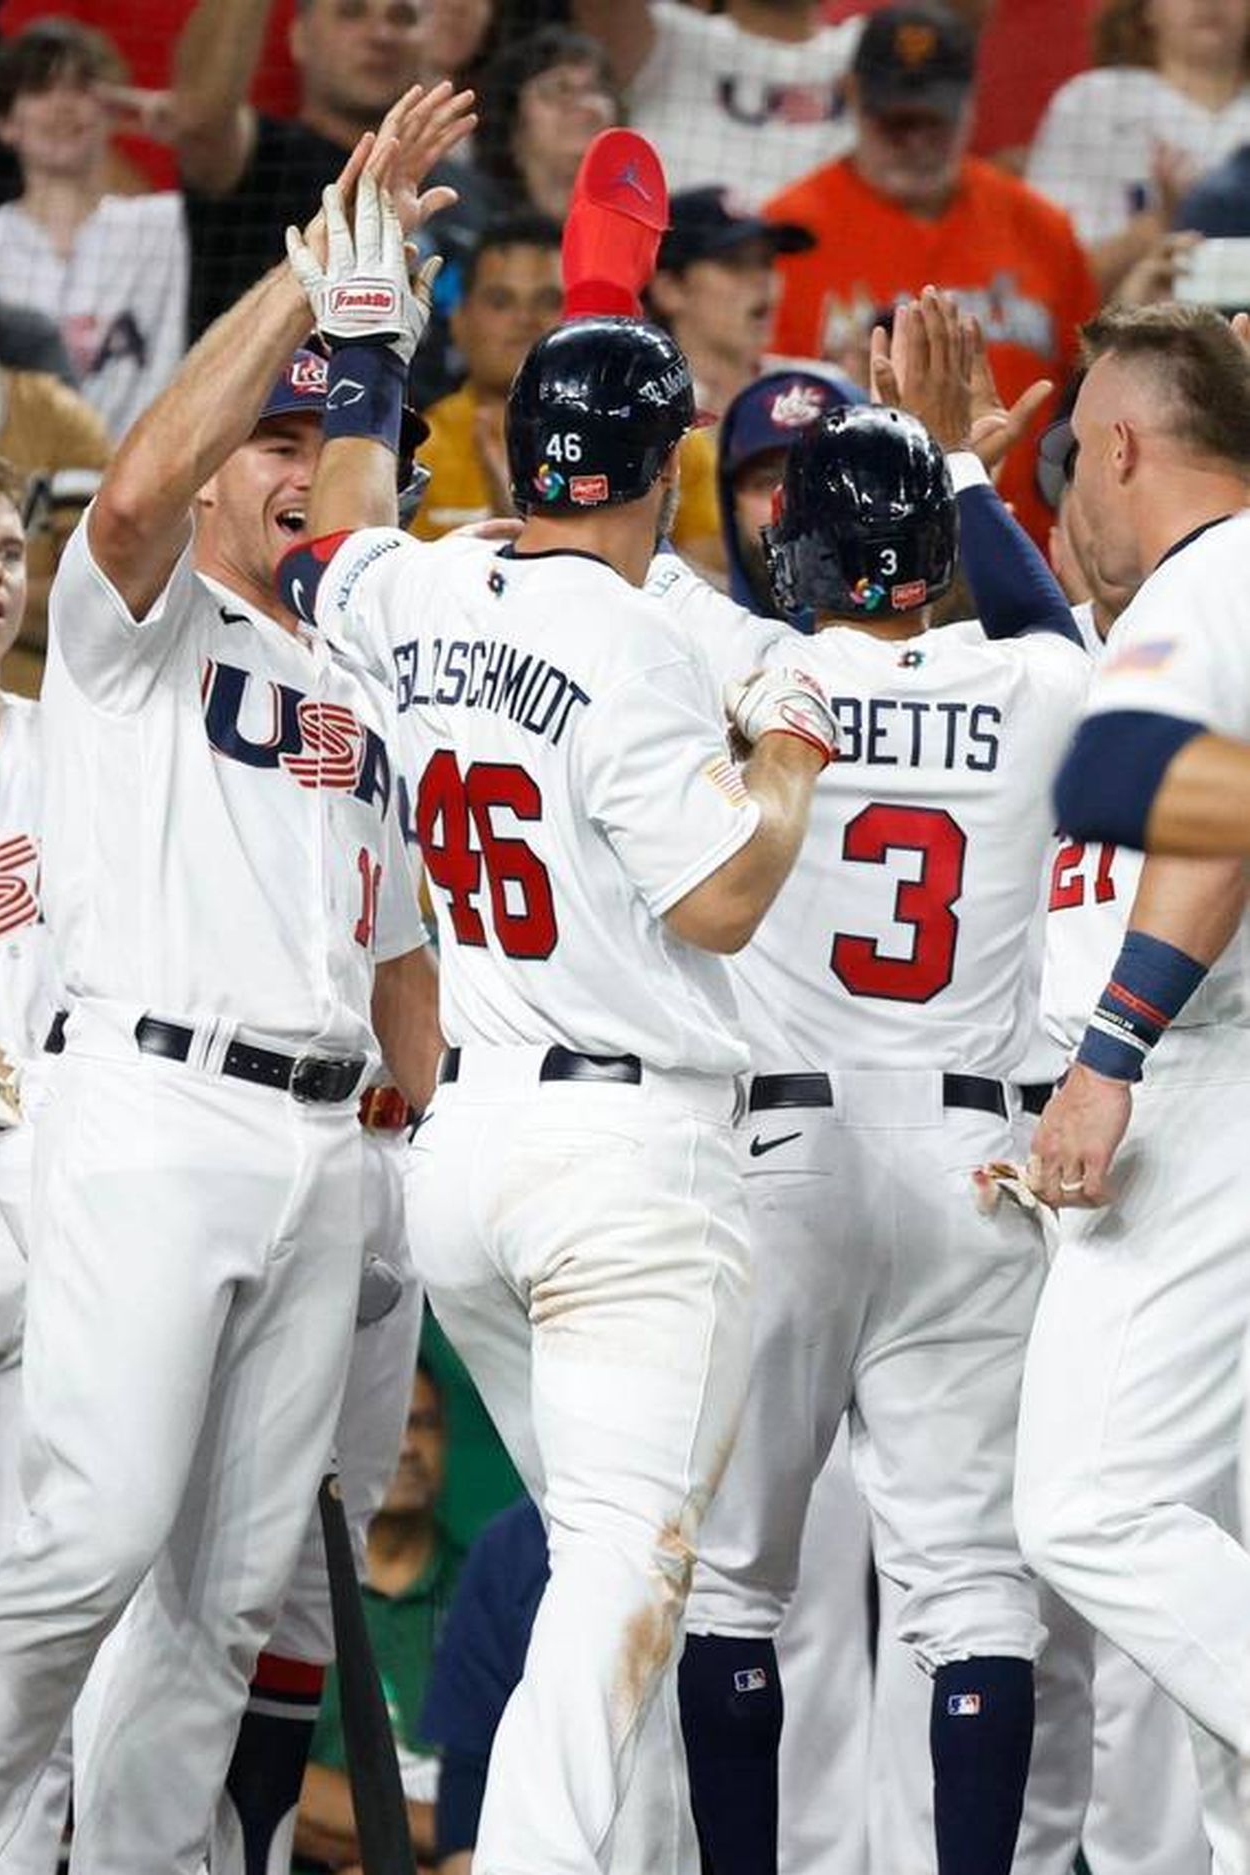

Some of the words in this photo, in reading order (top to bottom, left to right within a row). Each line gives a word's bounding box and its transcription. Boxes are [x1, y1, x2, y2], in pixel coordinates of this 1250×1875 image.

[546, 433, 582, 462] 46
[880, 548, 897, 575] 3
[201, 655, 391, 823] USA
[831, 697, 1002, 772] BETTS
[417, 748, 559, 961] 46
[830, 803, 967, 1004] 3
